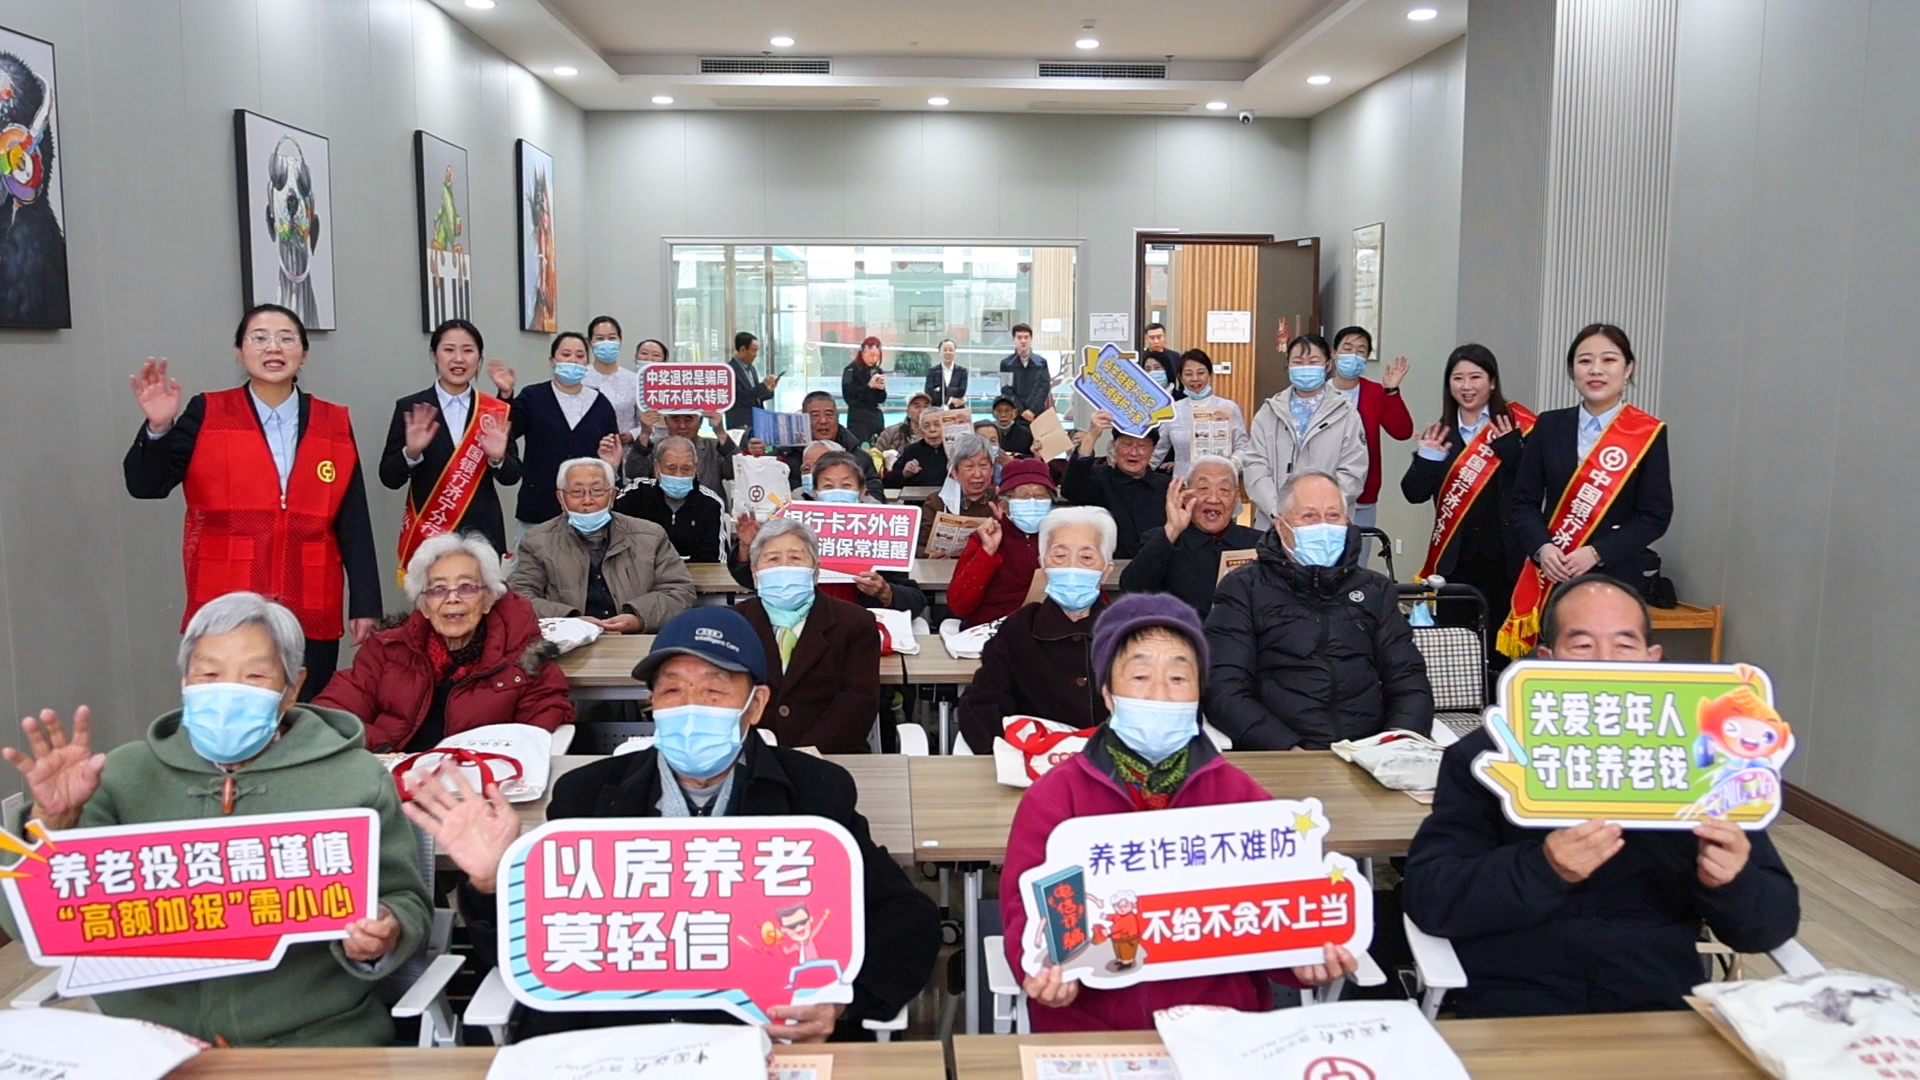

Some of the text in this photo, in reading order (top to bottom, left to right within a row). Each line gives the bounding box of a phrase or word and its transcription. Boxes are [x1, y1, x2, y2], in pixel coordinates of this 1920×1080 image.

[646, 369, 729, 386] 中奖退税是骗局
[646, 388, 729, 405] 不听不信不转账
[1432, 442, 1495, 547] 中国银行济宁分行
[1551, 469, 1613, 550] 中国银行济
[817, 537, 909, 560] 消保常提醒
[1530, 690, 1687, 738] 关爱老年人
[1531, 744, 1690, 791] 守住养老钱
[48, 831, 354, 899] 养老投资需谨慎
[541, 836, 816, 899] 以房养老
[1089, 826, 1297, 876] 养老诈骗不难防
[56, 882, 355, 942] “高额加报”需小心
[1142, 893, 1348, 944] 不给不贪不上当
[541, 910, 732, 973] 莫轻信
